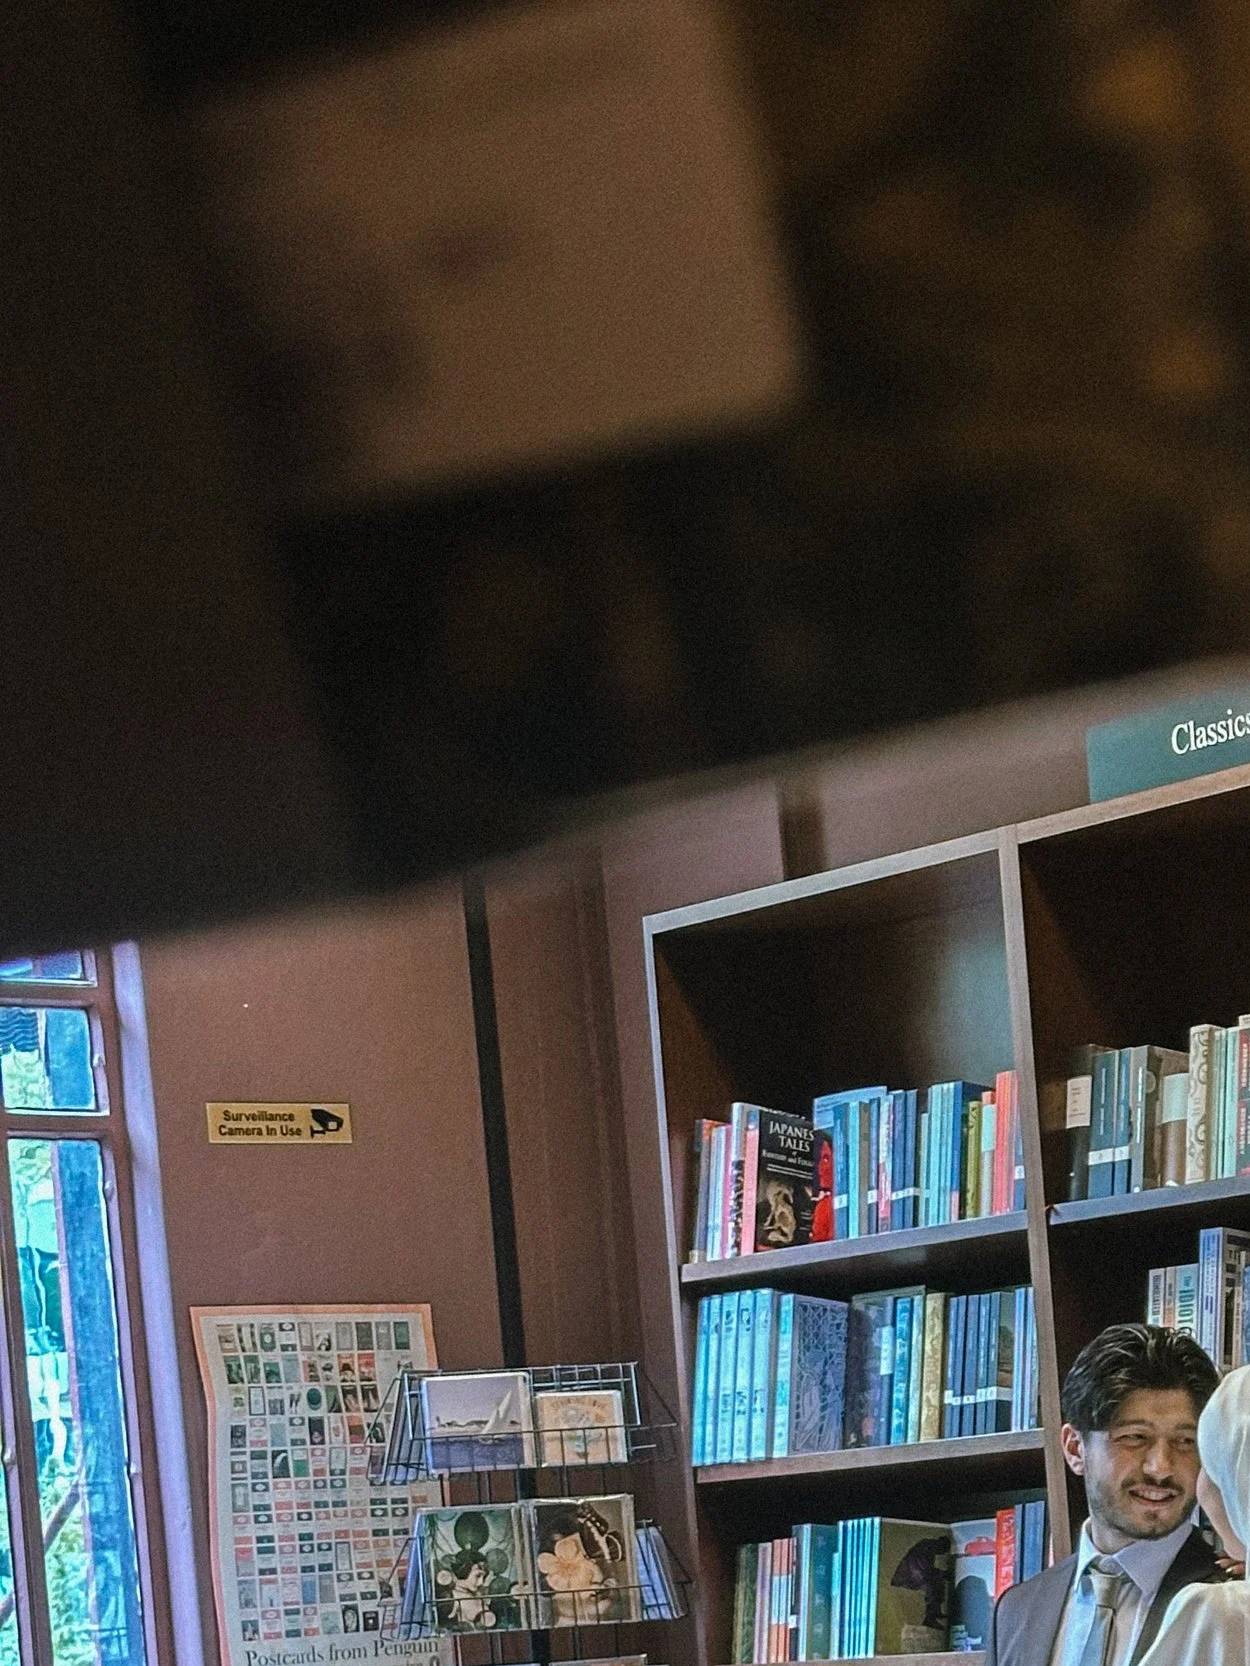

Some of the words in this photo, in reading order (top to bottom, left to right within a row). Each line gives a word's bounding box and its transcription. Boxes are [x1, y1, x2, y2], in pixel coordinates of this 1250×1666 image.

[223, 1109, 295, 1122] Surveillance
[218, 1124, 263, 1136] Camera
[265, 1124, 277, 1136] In
[280, 1124, 302, 1136] Use
[769, 1120, 815, 1142] JAPANES
[779, 1135, 811, 1152] TALES
[1178, 1288, 1195, 1324] IDIOT
[328, 1642, 368, 1661] from
[373, 1639, 439, 1660] Penguin
